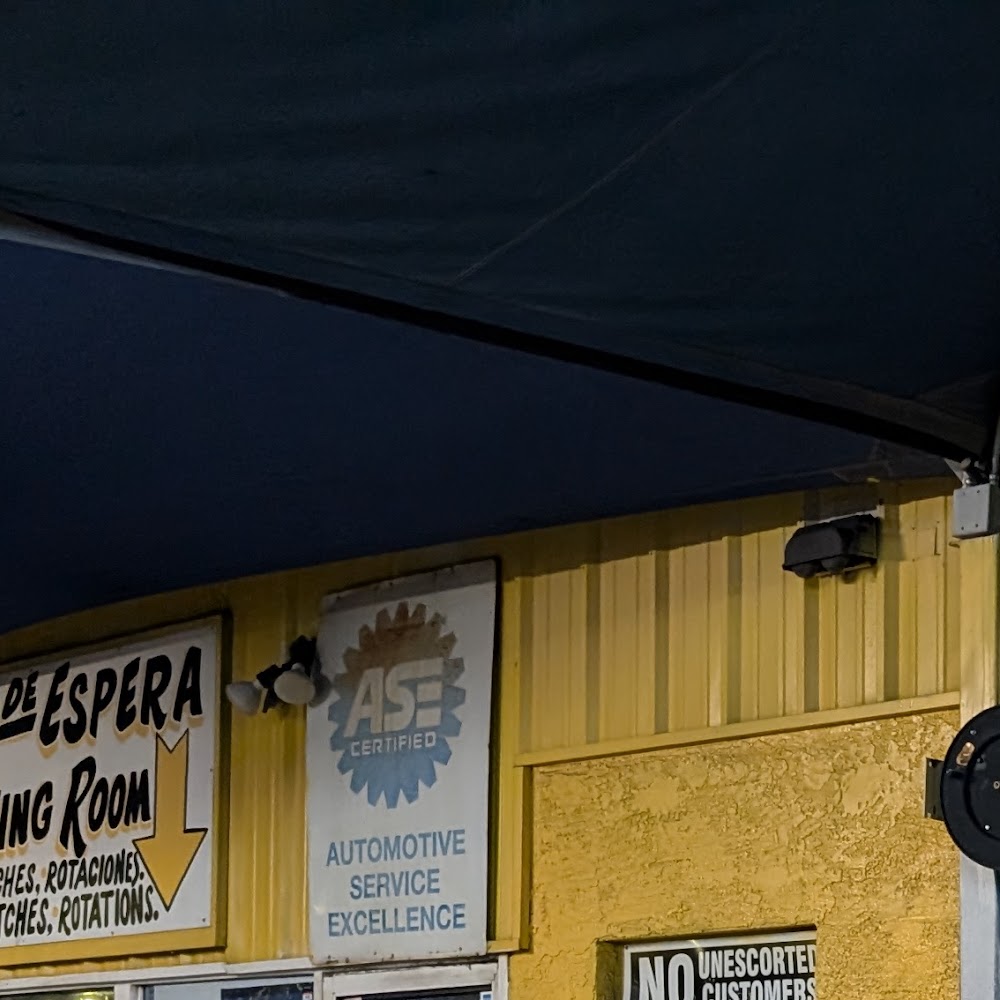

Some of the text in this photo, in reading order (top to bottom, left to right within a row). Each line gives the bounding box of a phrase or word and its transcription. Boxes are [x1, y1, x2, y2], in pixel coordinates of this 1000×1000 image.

[2, 646, 203, 746] DE ESPERA
[343, 657, 444, 739] ASE
[350, 731, 437, 757] CERTIFIED
[0, 756, 152, 858] ING ROOM
[325, 829, 466, 867] AUTOMOTIVE
[44, 849, 145, 895] ROTACIONES.
[349, 868, 441, 900] SERVICE
[58, 884, 159, 936] ROTATIONS.
[328, 903, 466, 937] EXCELLENCE
[698, 944, 816, 979] UNESCORTED
